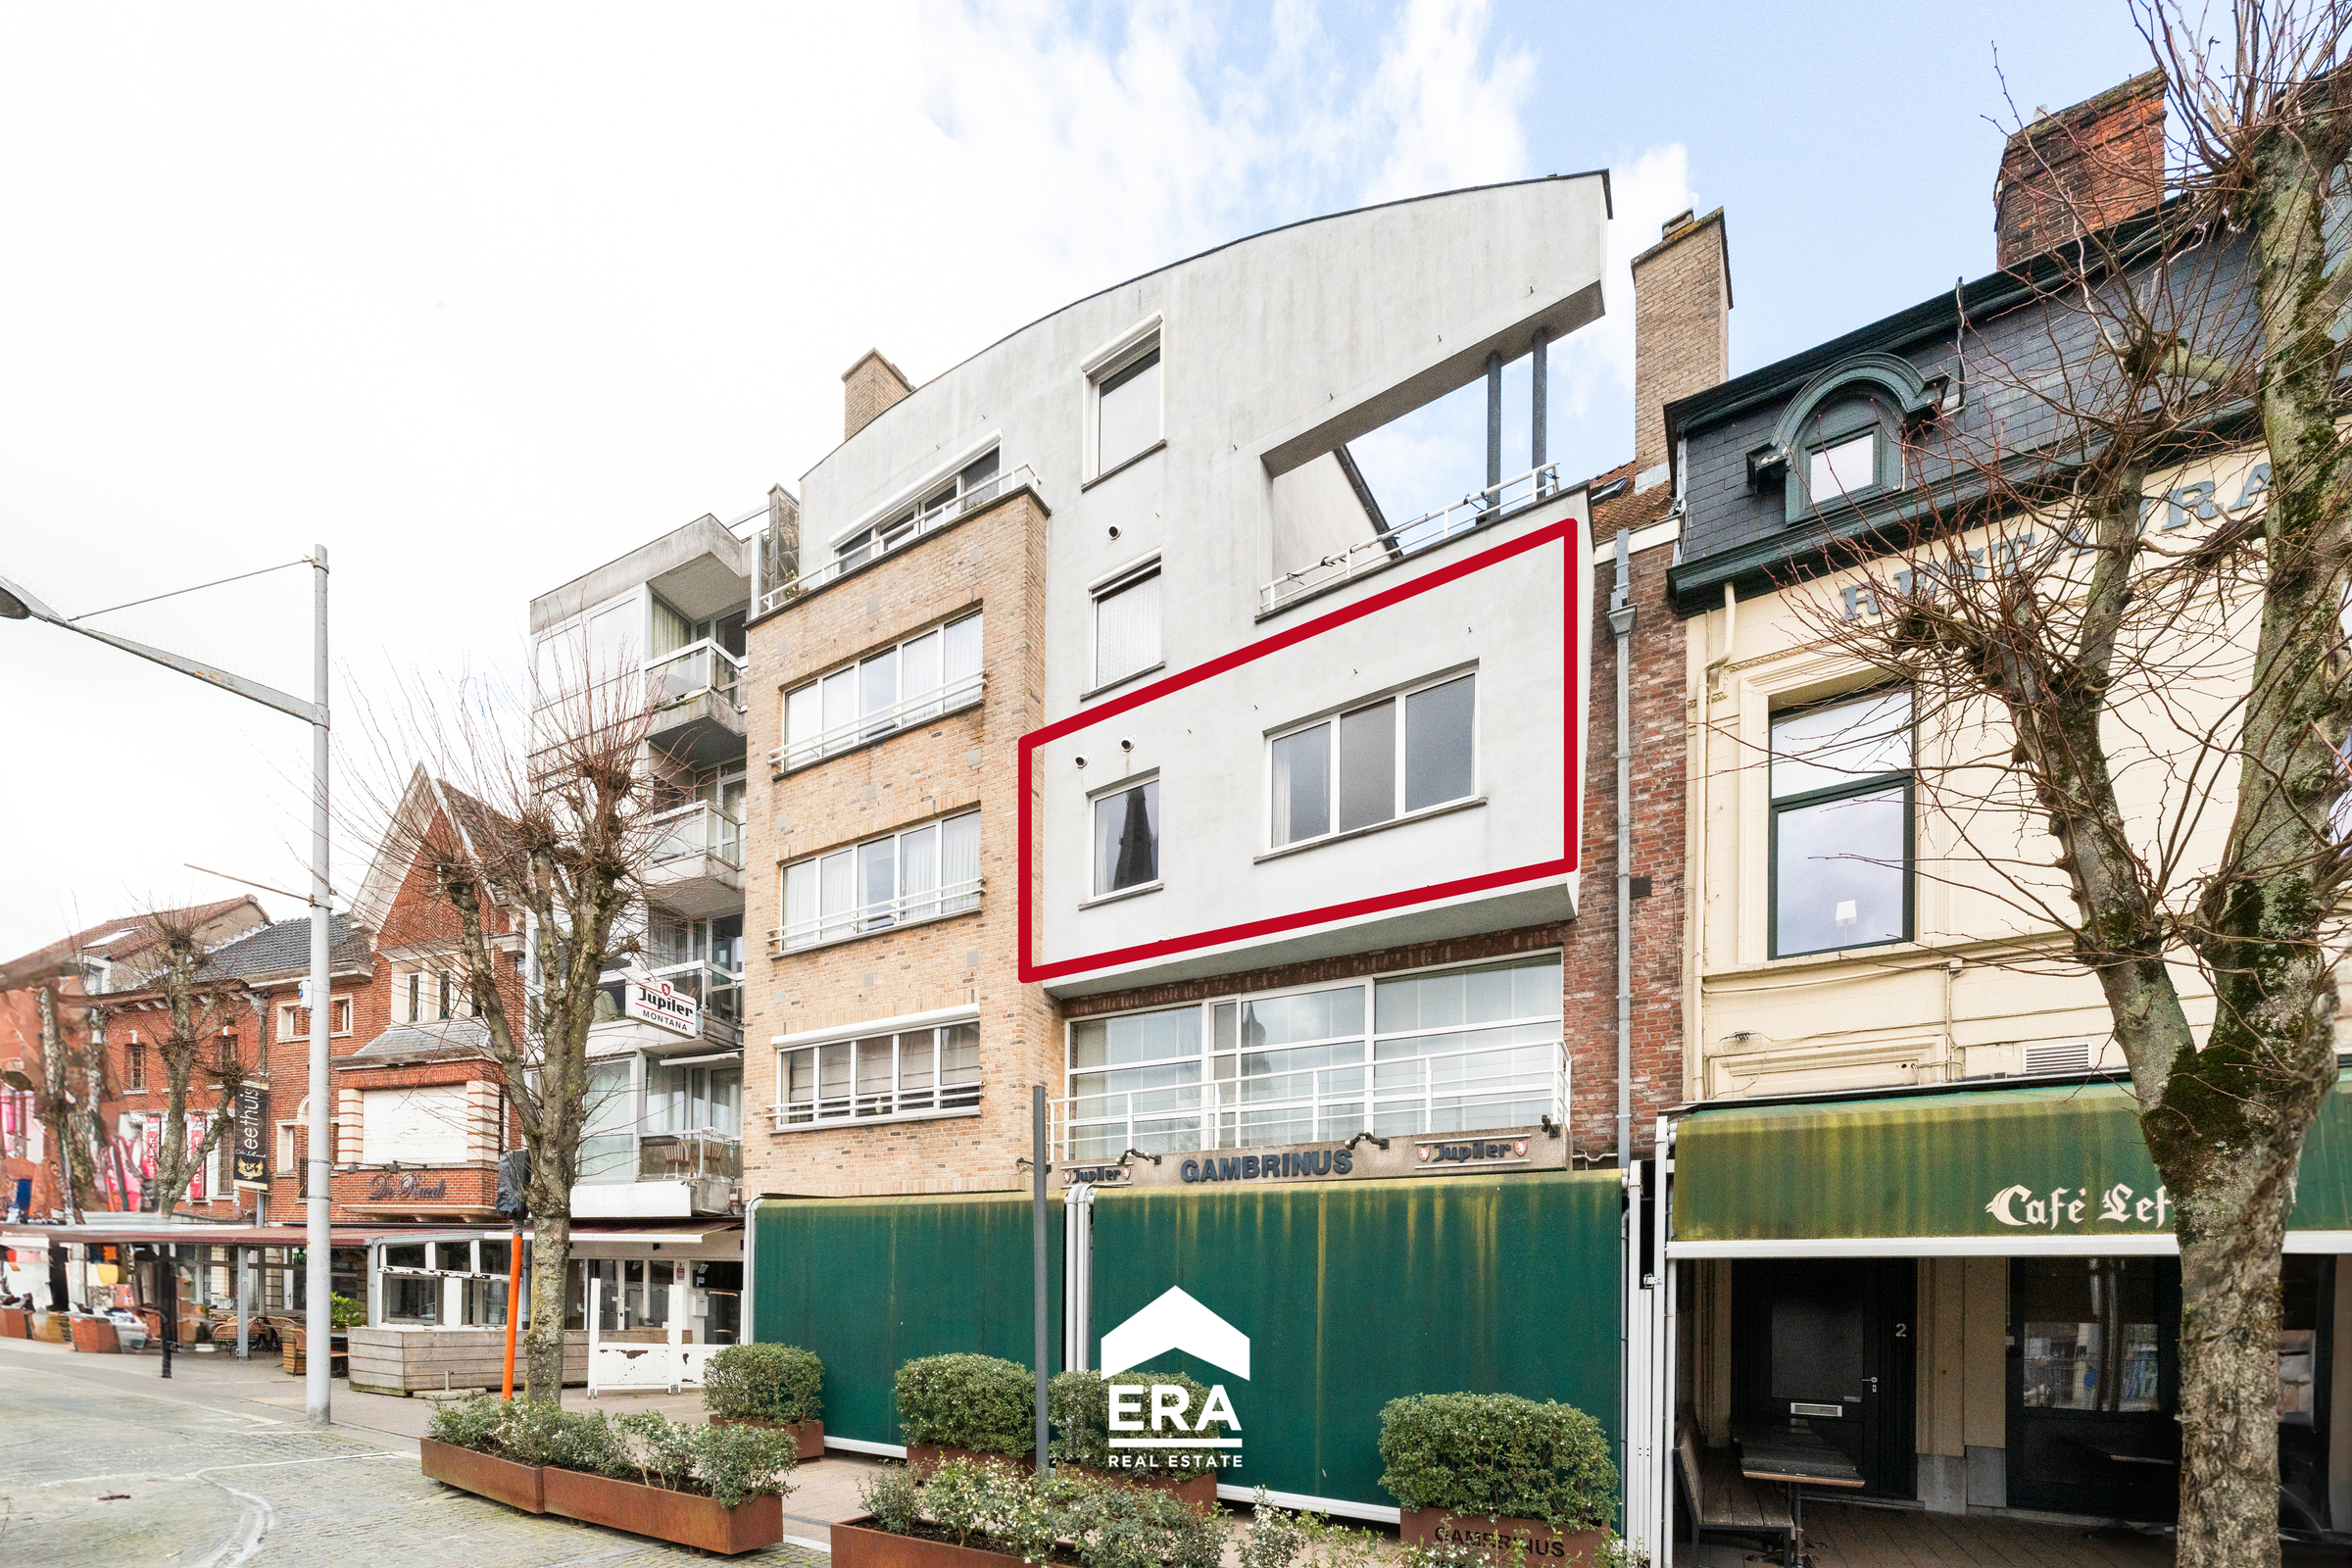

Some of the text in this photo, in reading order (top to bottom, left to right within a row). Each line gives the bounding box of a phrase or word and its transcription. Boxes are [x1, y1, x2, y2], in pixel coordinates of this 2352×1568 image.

[638, 987, 693, 1017] Jupiler
[643, 1009, 688, 1031] MONTANA
[240, 1088, 259, 1150] eethuis
[1432, 1140, 1511, 1163] Jupiler
[1072, 1166, 1121, 1183] Jupiler
[1180, 1149, 1353, 1183] GAMBRINUS
[368, 1173, 396, 1200] De
[1984, 1183, 2173, 1230] Café Lef
[1895, 1322, 1907, 1338] 2
